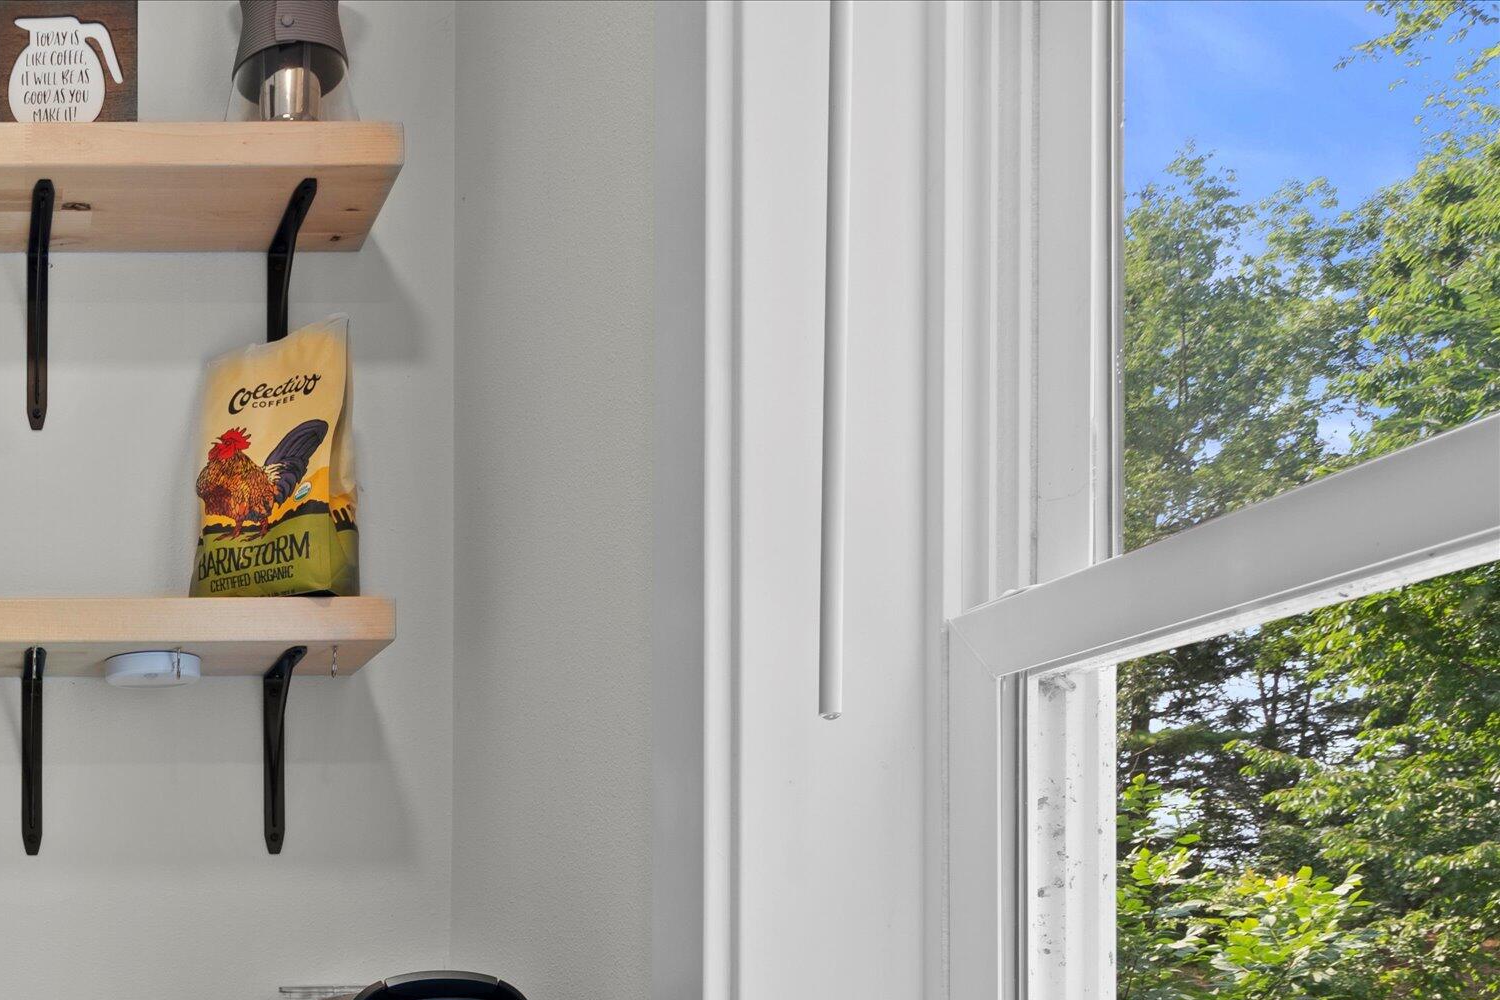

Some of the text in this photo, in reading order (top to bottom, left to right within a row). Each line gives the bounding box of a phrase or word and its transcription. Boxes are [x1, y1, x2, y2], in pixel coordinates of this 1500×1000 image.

[36, 29, 79, 47] TODAY IS
[25, 49, 87, 66] LIKE COFFEE,
[21, 68, 90, 86] IT WILL BE AS
[23, 88, 89, 105] GOOD AS YOU
[32, 106, 77, 122] MAKE IT!
[228, 373, 322, 415] Colectivo
[252, 394, 295, 409] COFFEE
[198, 531, 310, 582] BARNSTORM
[210, 565, 294, 593] CERTIFIED ORGANIC
